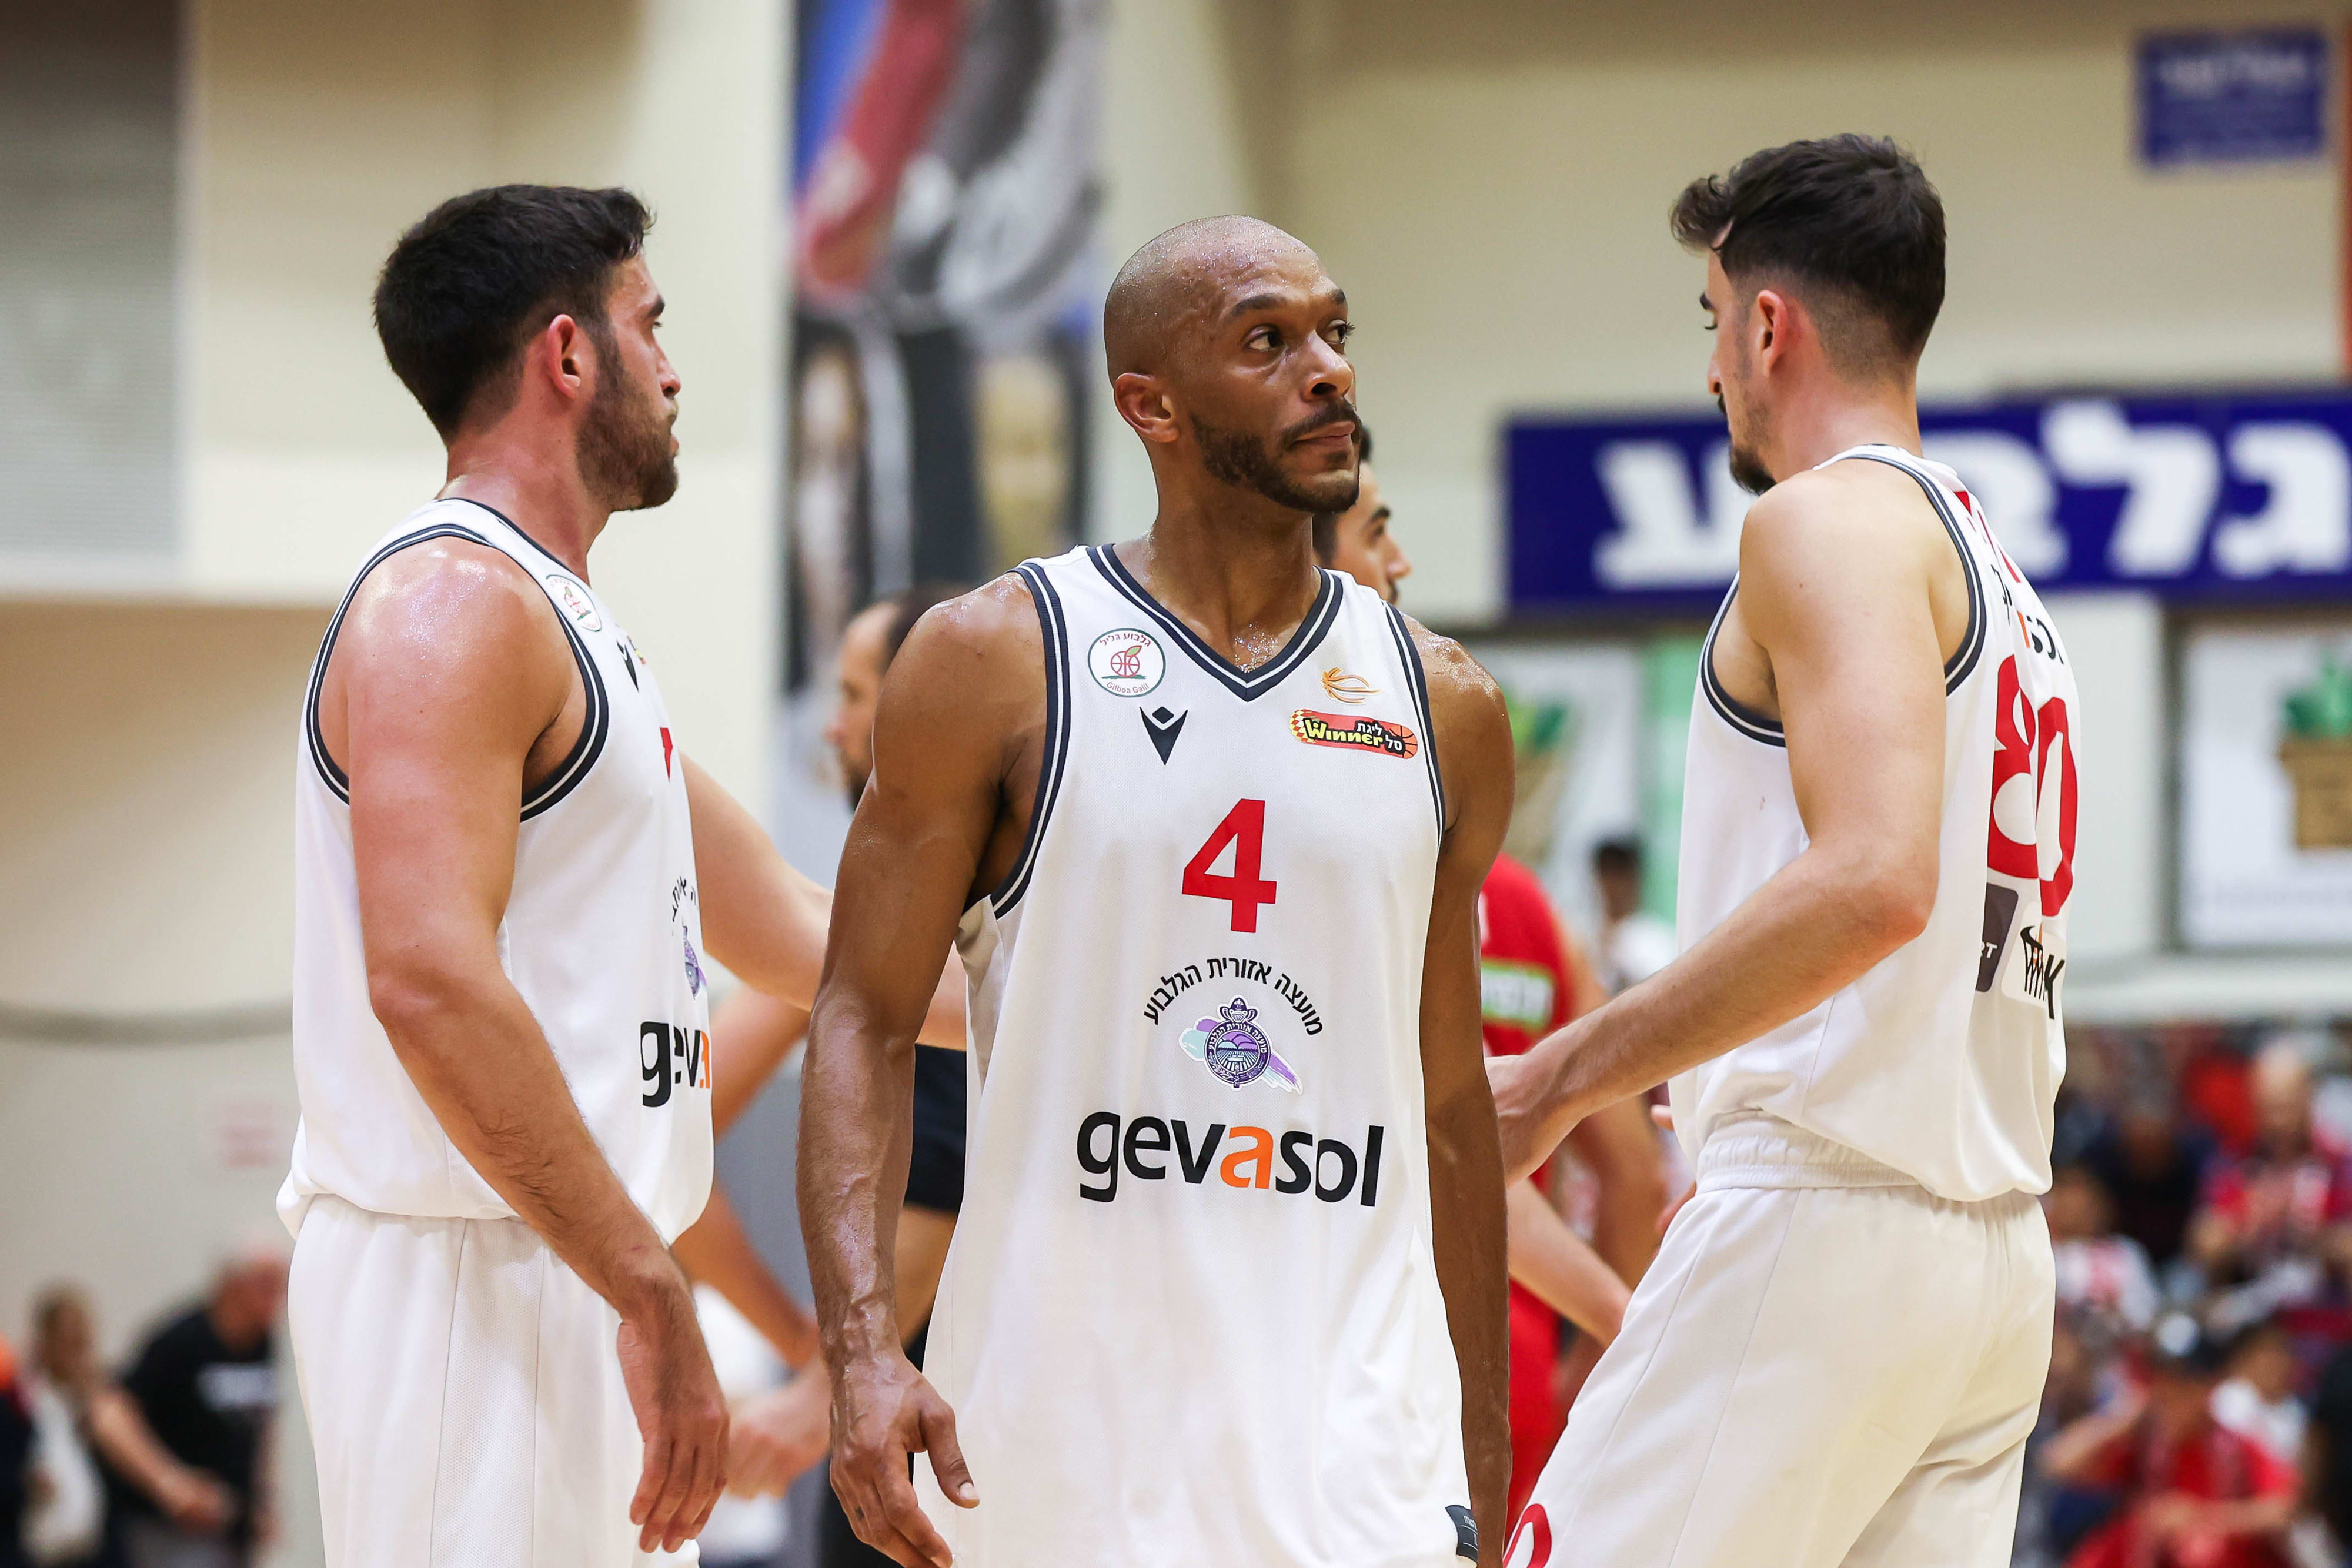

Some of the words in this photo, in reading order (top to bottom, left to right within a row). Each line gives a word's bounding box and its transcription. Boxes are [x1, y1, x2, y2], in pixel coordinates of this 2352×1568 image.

[1100, 634, 1120, 645] גליל
[1124, 633, 1151, 647] גלבוע
[1107, 681, 1131, 694] Gilboa
[1132, 683, 1150, 693] Galil
[1356, 723, 1382, 736] ליגת
[1385, 735, 1402, 751] סל
[1182, 798, 1277, 933] 4
[1207, 957, 1272, 985] אזורית
[1143, 965, 1203, 1025] הגלבוע
[1274, 973, 1323, 1035] מועצה
[1077, 1111, 1384, 1207] gevasol
